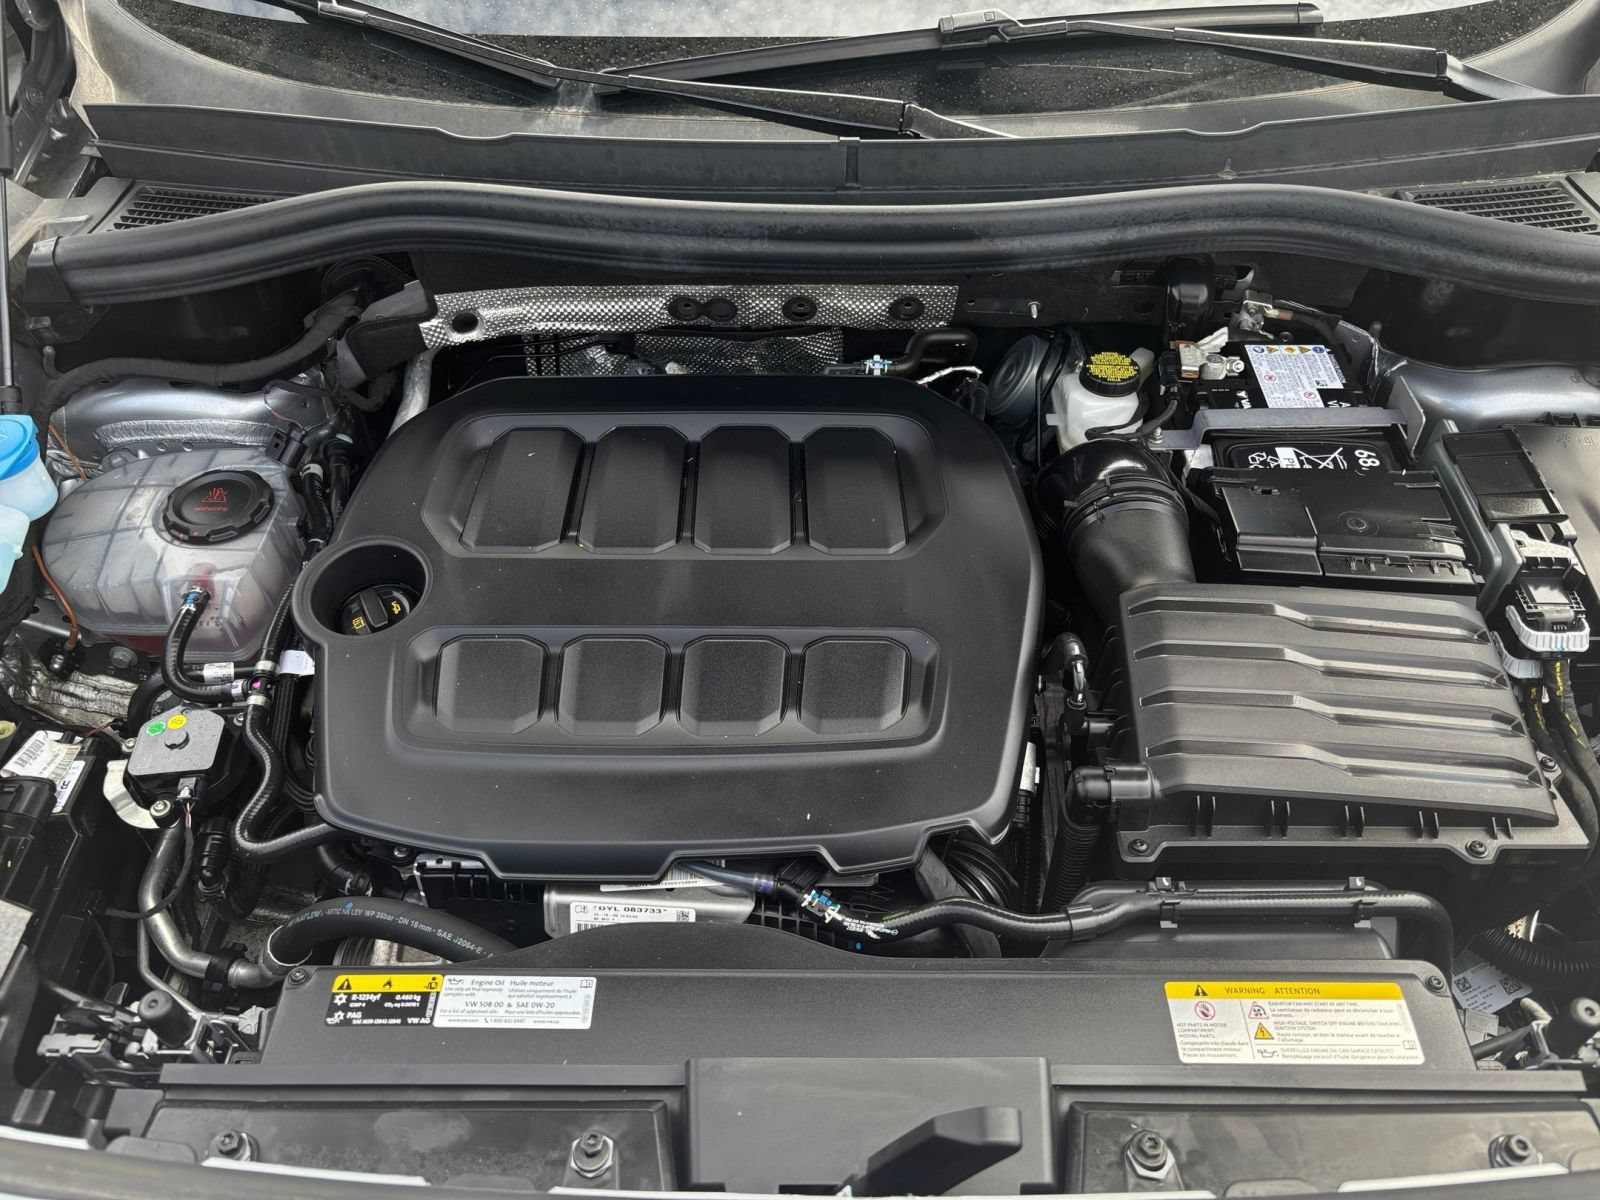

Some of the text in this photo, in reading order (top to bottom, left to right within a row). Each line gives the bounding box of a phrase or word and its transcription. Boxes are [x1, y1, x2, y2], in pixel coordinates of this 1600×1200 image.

[398, 916, 410, 926] DN
[418, 923, 432, 933] mm
[436, 928, 454, 941] SAE
[471, 979, 494, 988] Engine
[509, 979, 528, 987] Huile
[1224, 986, 1321, 995] WARNING ATTENTION
[531, 1001, 555, 1009] 0W-20
[346, 1011, 362, 1019] PAG
